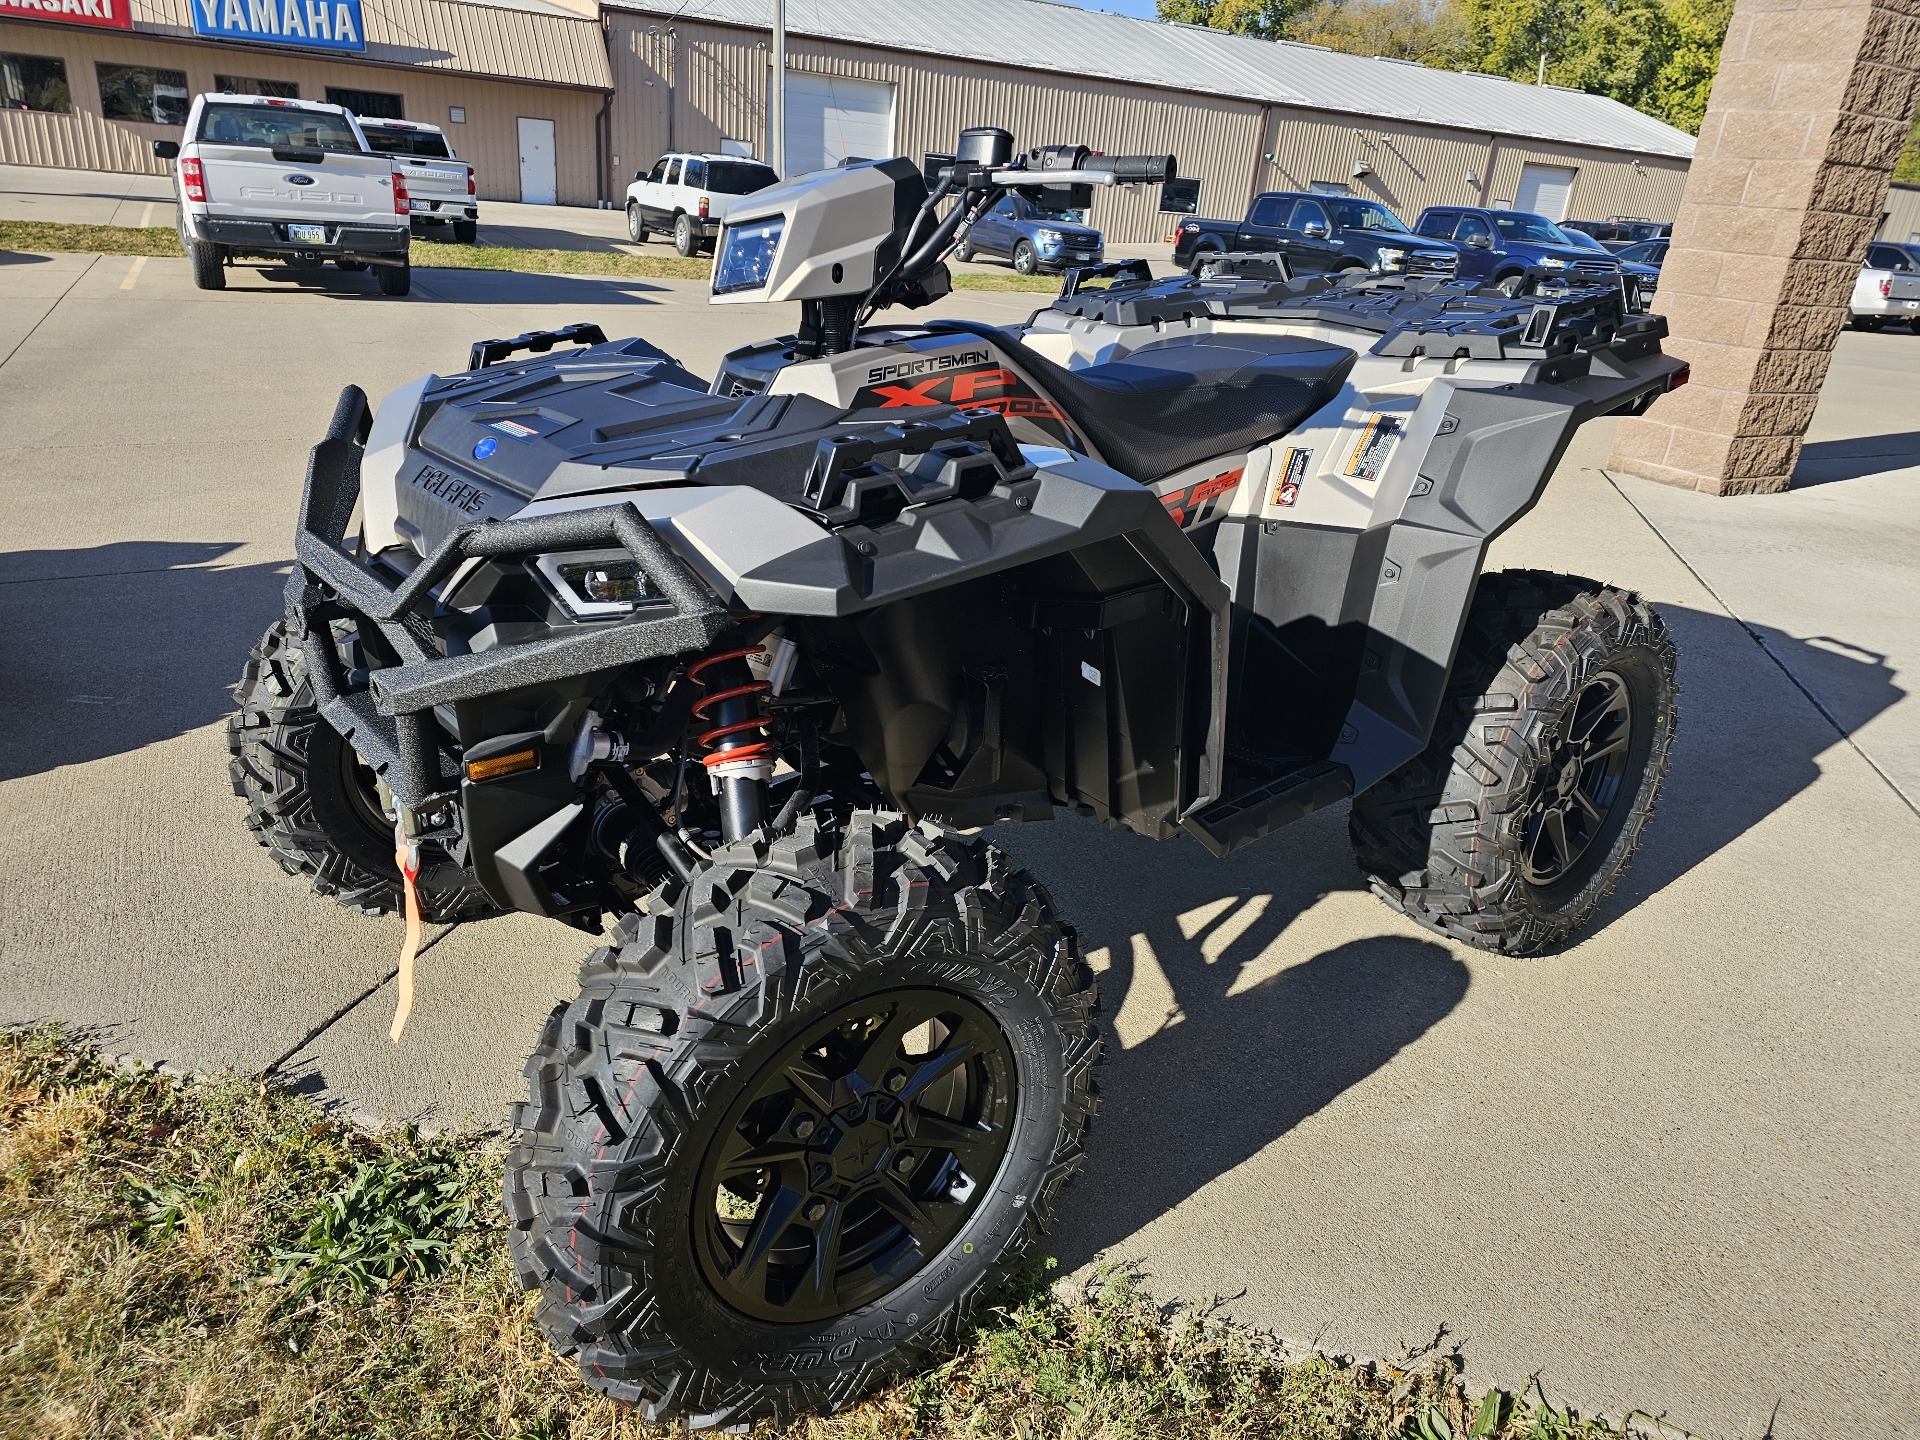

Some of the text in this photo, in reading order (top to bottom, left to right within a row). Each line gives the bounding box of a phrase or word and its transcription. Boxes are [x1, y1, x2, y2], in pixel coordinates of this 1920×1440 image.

[0, 0, 112, 19] SAKI
[201, 0, 359, 42] YAMAHA
[240, 186, 364, 205] F-150
[867, 350, 989, 384] SPORTSMAN
[869, 369, 1017, 408] XP
[412, 464, 492, 516] POLARIS
